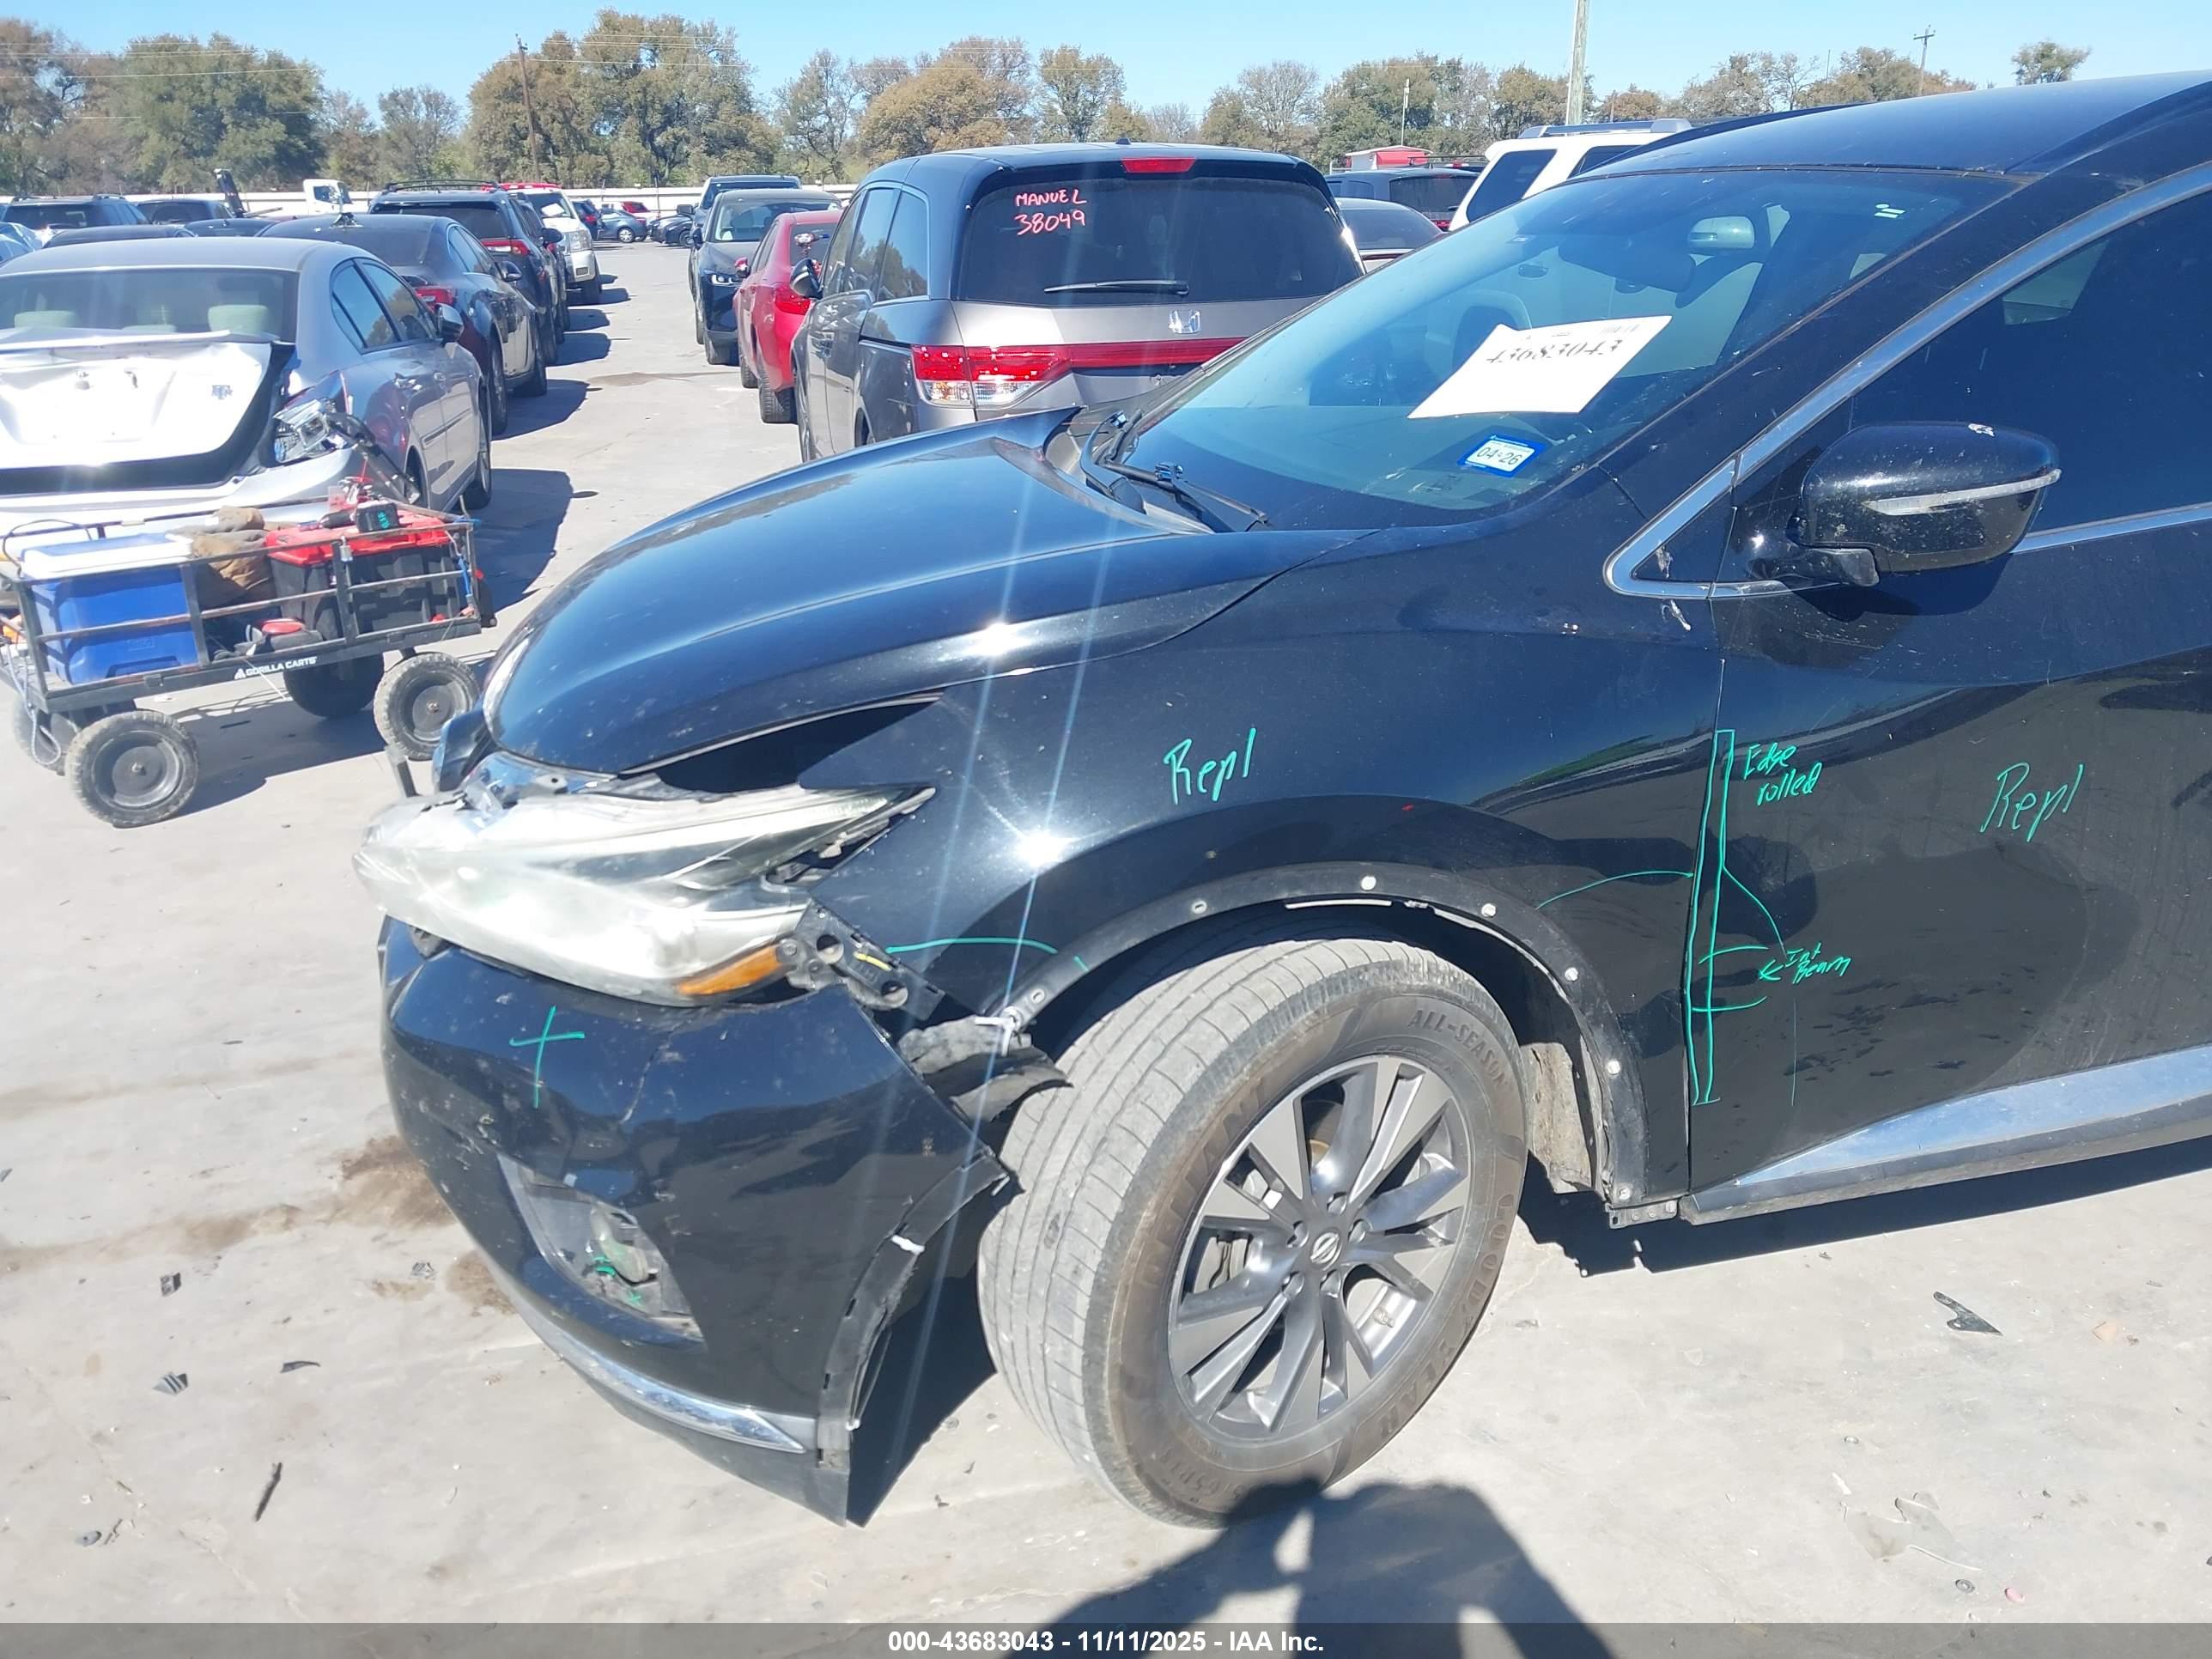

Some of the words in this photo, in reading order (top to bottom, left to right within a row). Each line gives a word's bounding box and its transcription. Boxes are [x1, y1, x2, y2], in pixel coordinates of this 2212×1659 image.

[1016, 189, 1087, 206] MANUEL
[1014, 210, 1085, 235] 38049
[246, 663, 284, 677] GORILLA
[285, 656, 318, 669] CARTS
[1164, 727, 1256, 805] Repl
[1757, 762, 1823, 806] rolled
[1978, 762, 2084, 842] Repl
[1407, 1009, 1509, 1090] ALL-SEASON
